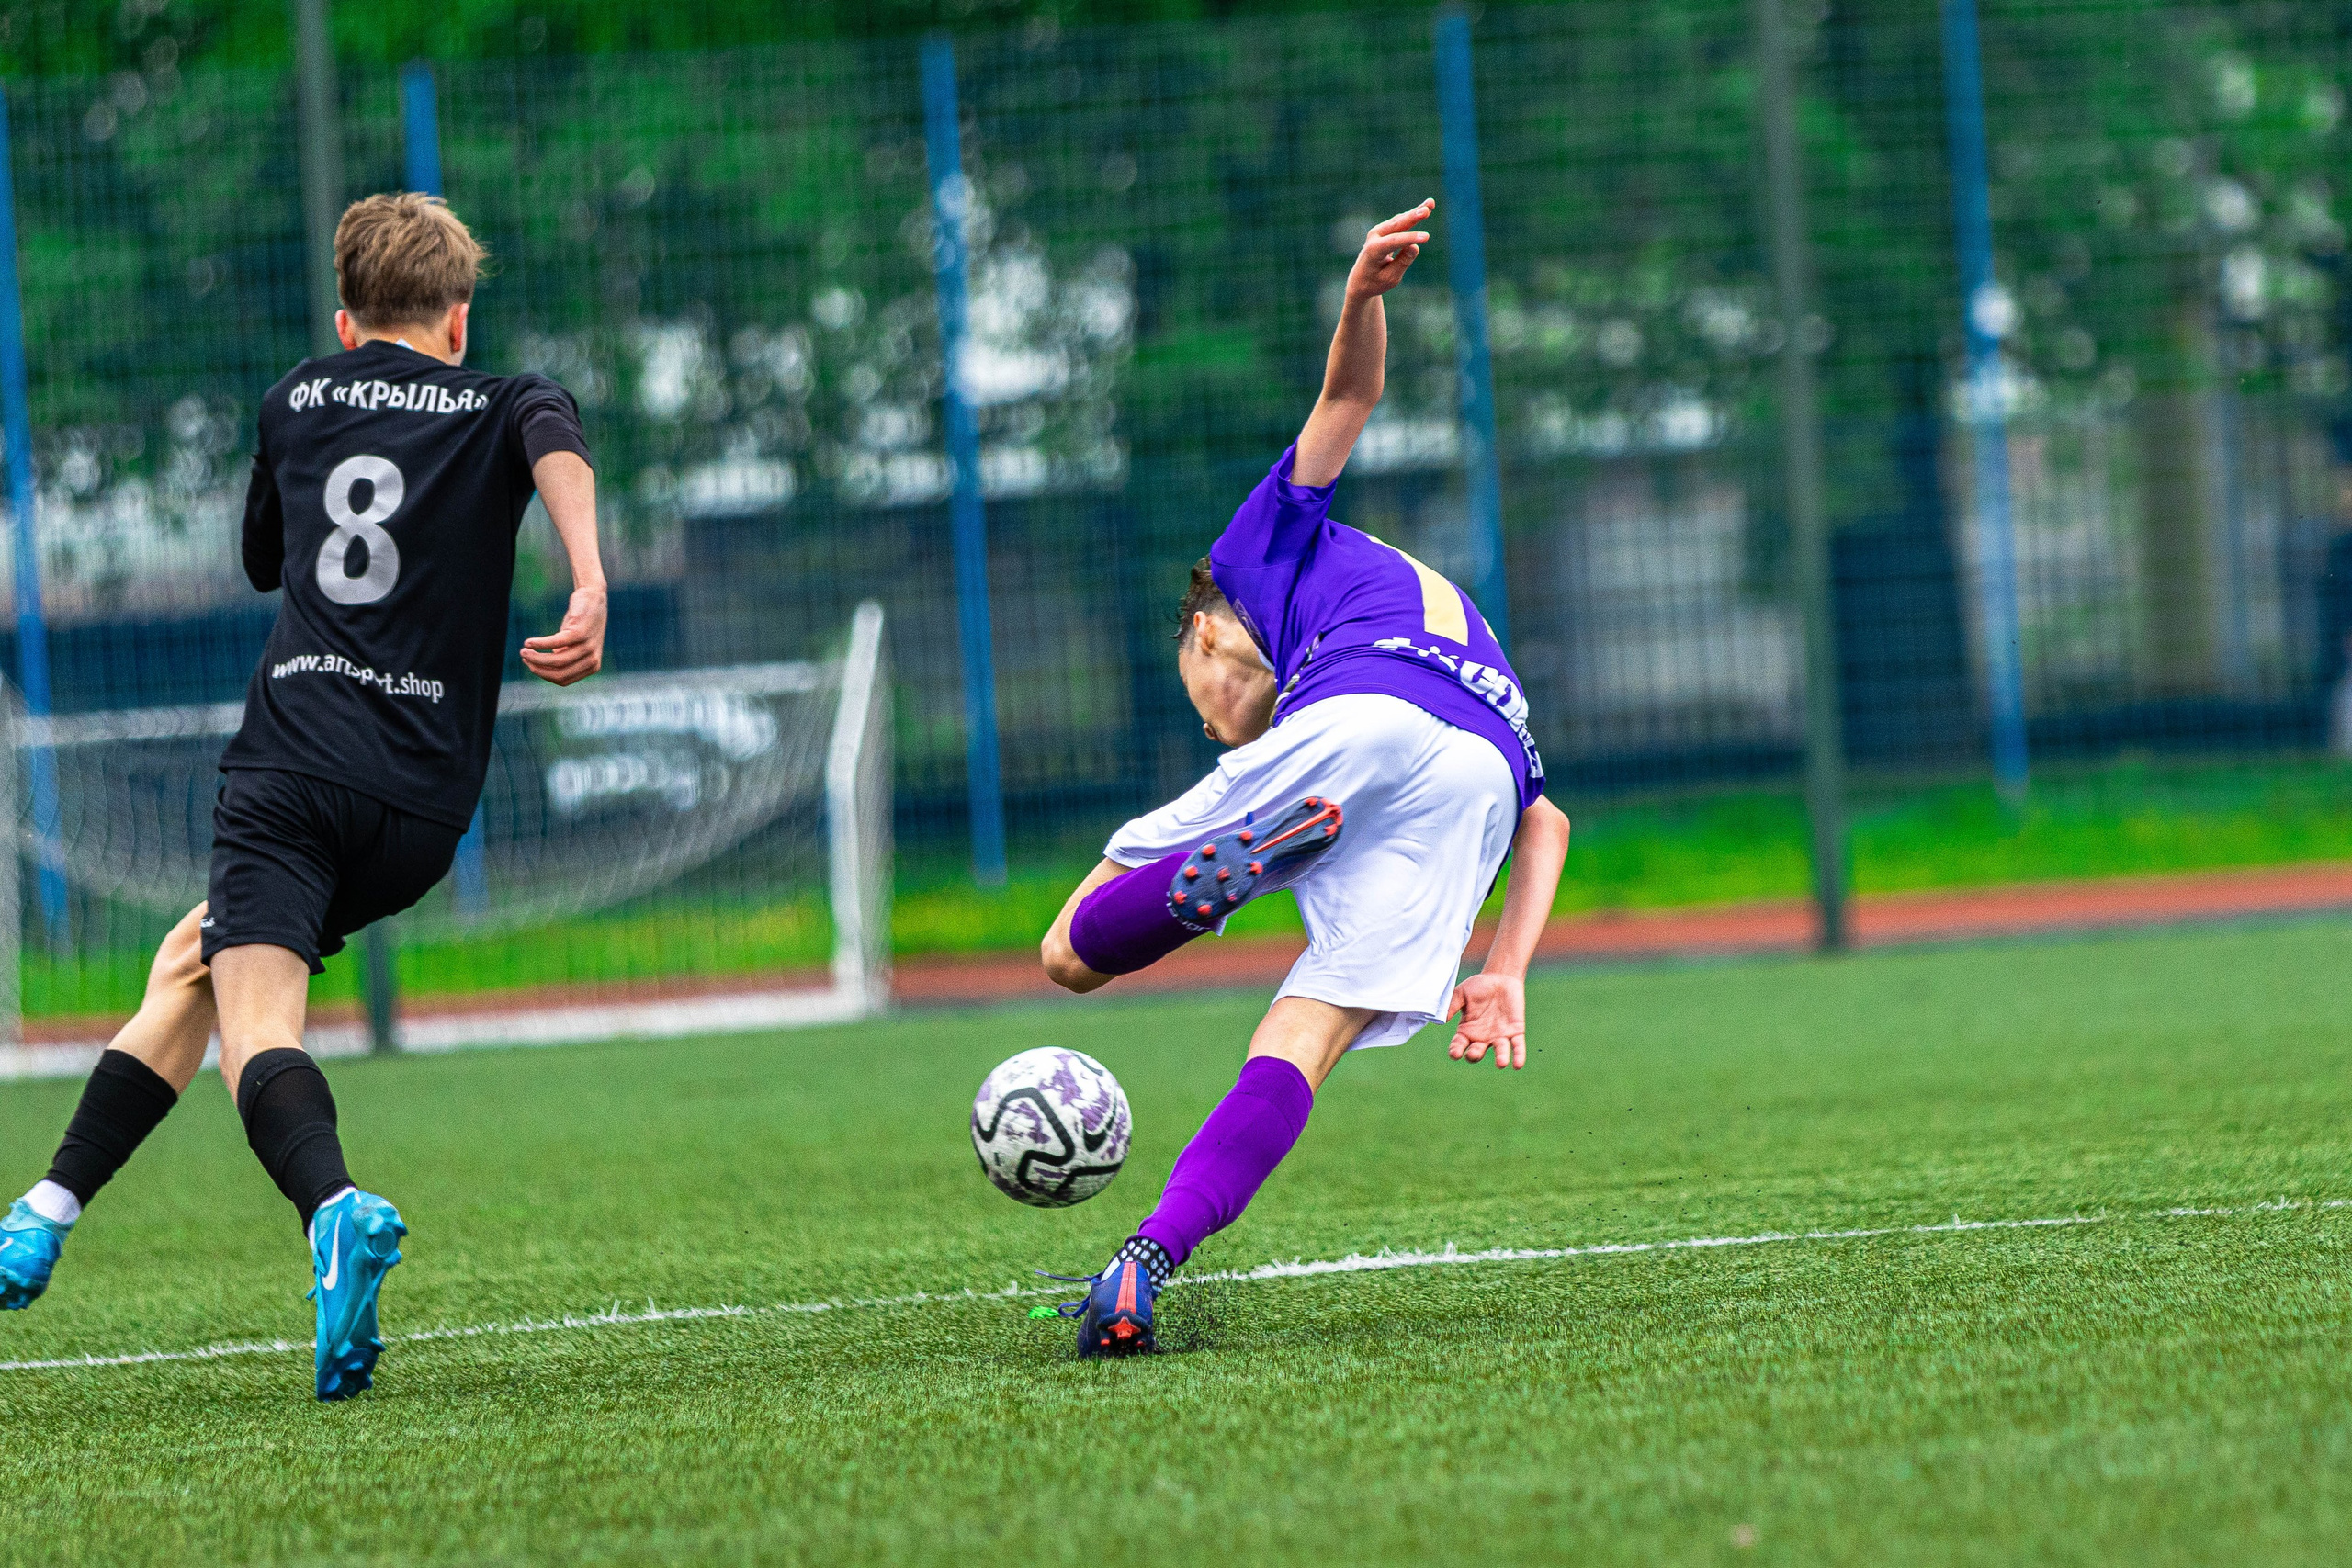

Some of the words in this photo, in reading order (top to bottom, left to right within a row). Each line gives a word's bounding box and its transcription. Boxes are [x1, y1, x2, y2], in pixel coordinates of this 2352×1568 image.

[289, 378, 332, 412] ФК
[316, 454, 405, 605] 8
[272, 654, 445, 703] www.artsprt.shop
